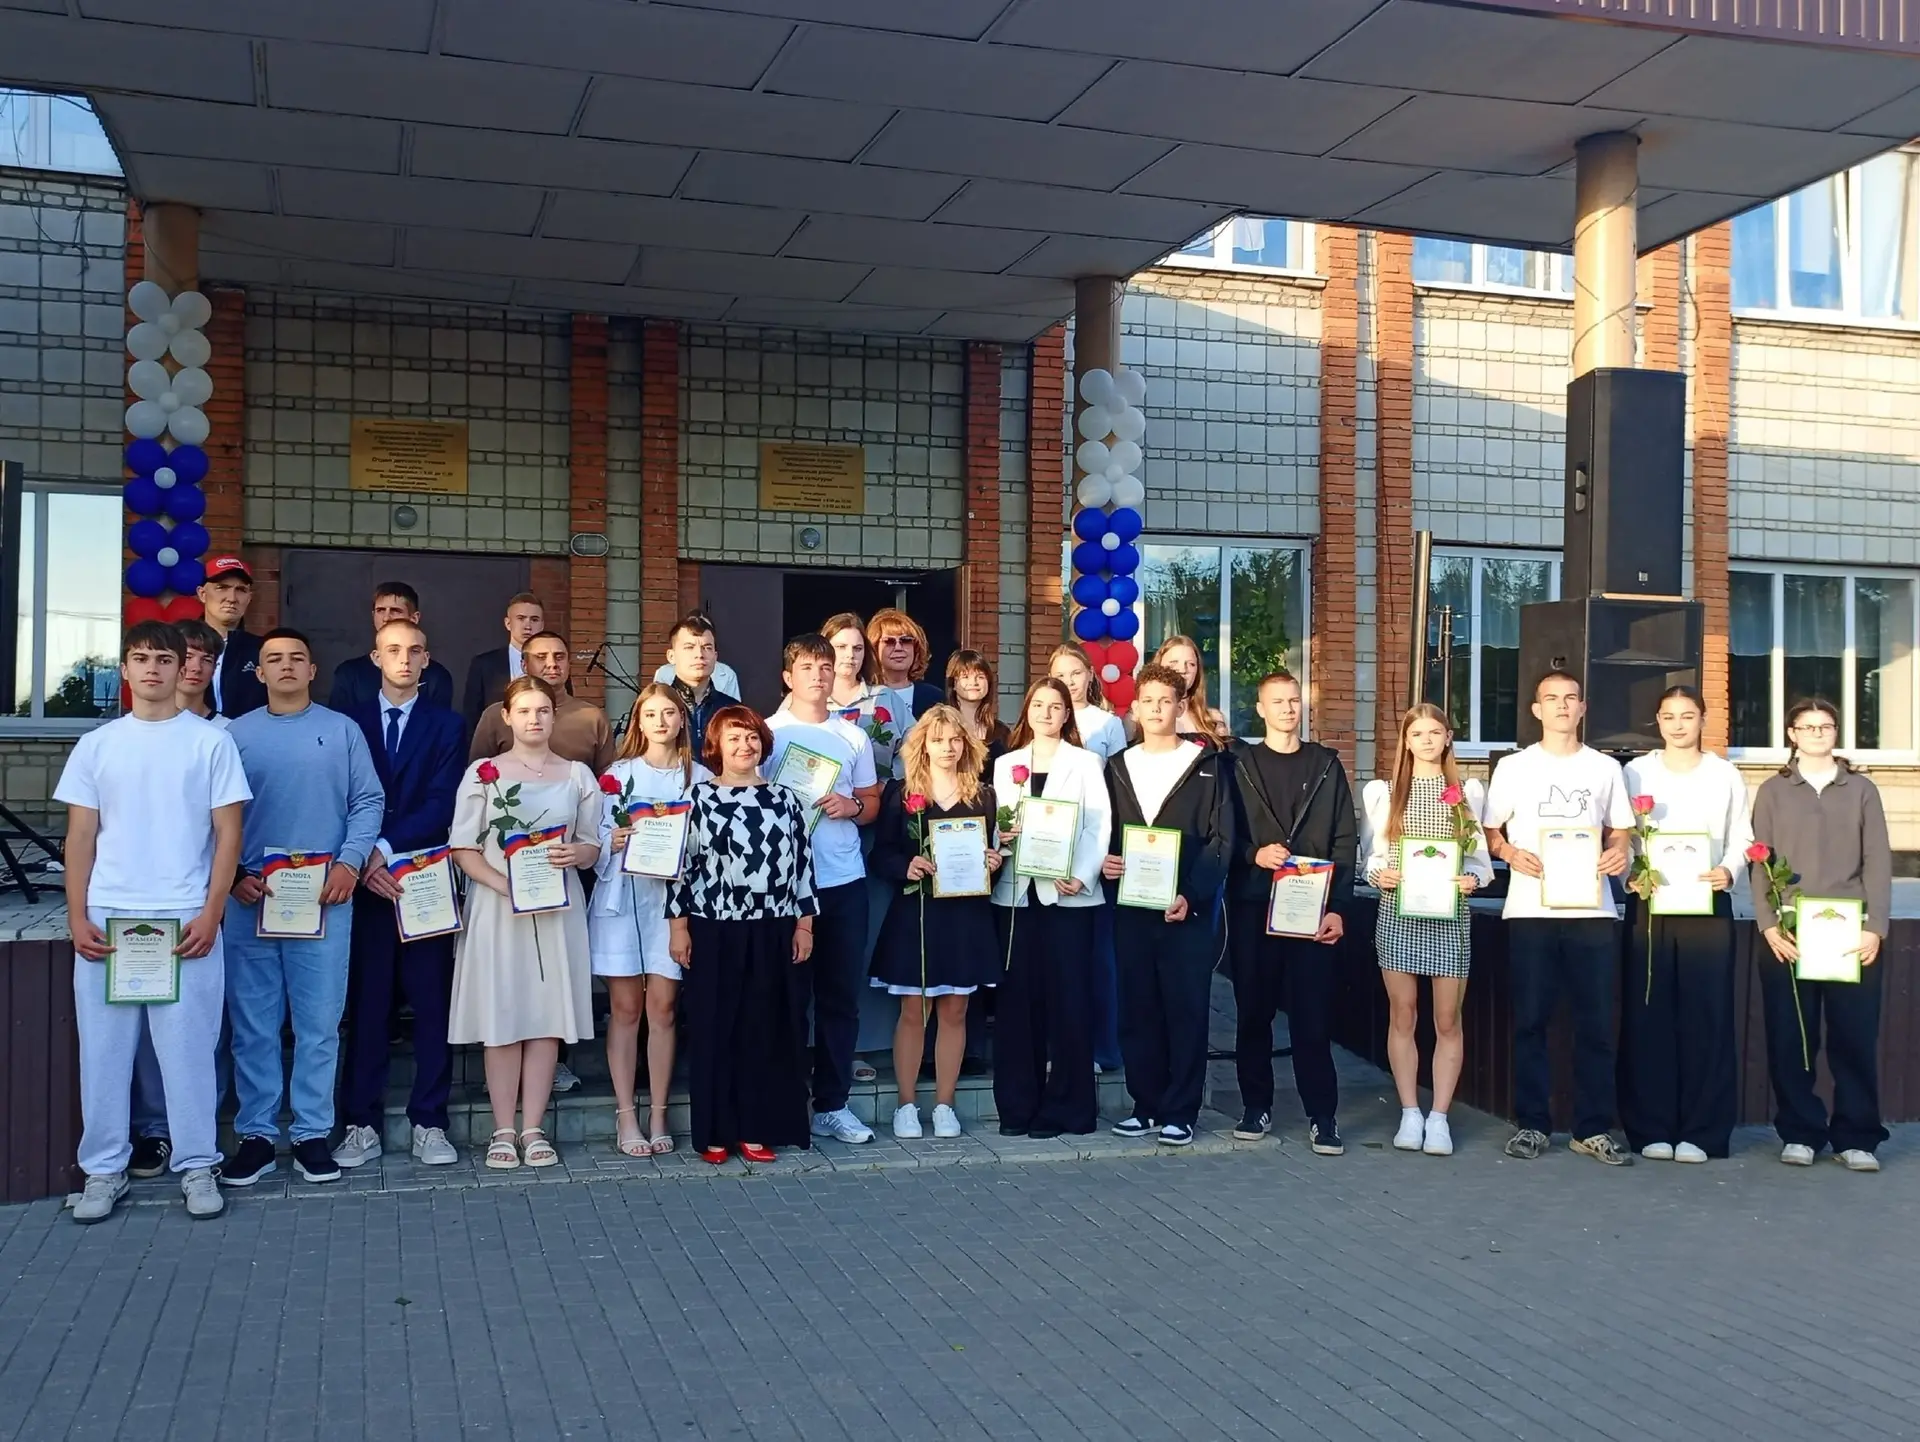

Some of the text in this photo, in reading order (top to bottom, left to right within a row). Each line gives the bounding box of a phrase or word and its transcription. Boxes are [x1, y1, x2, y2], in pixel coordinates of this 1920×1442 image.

[644, 820, 673, 828] ГРАМОТА
[280, 872, 312, 880] ГРАМОТА
[407, 872, 438, 882] ГРАМОТА
[1288, 878, 1315, 886] ГРАМОТА
